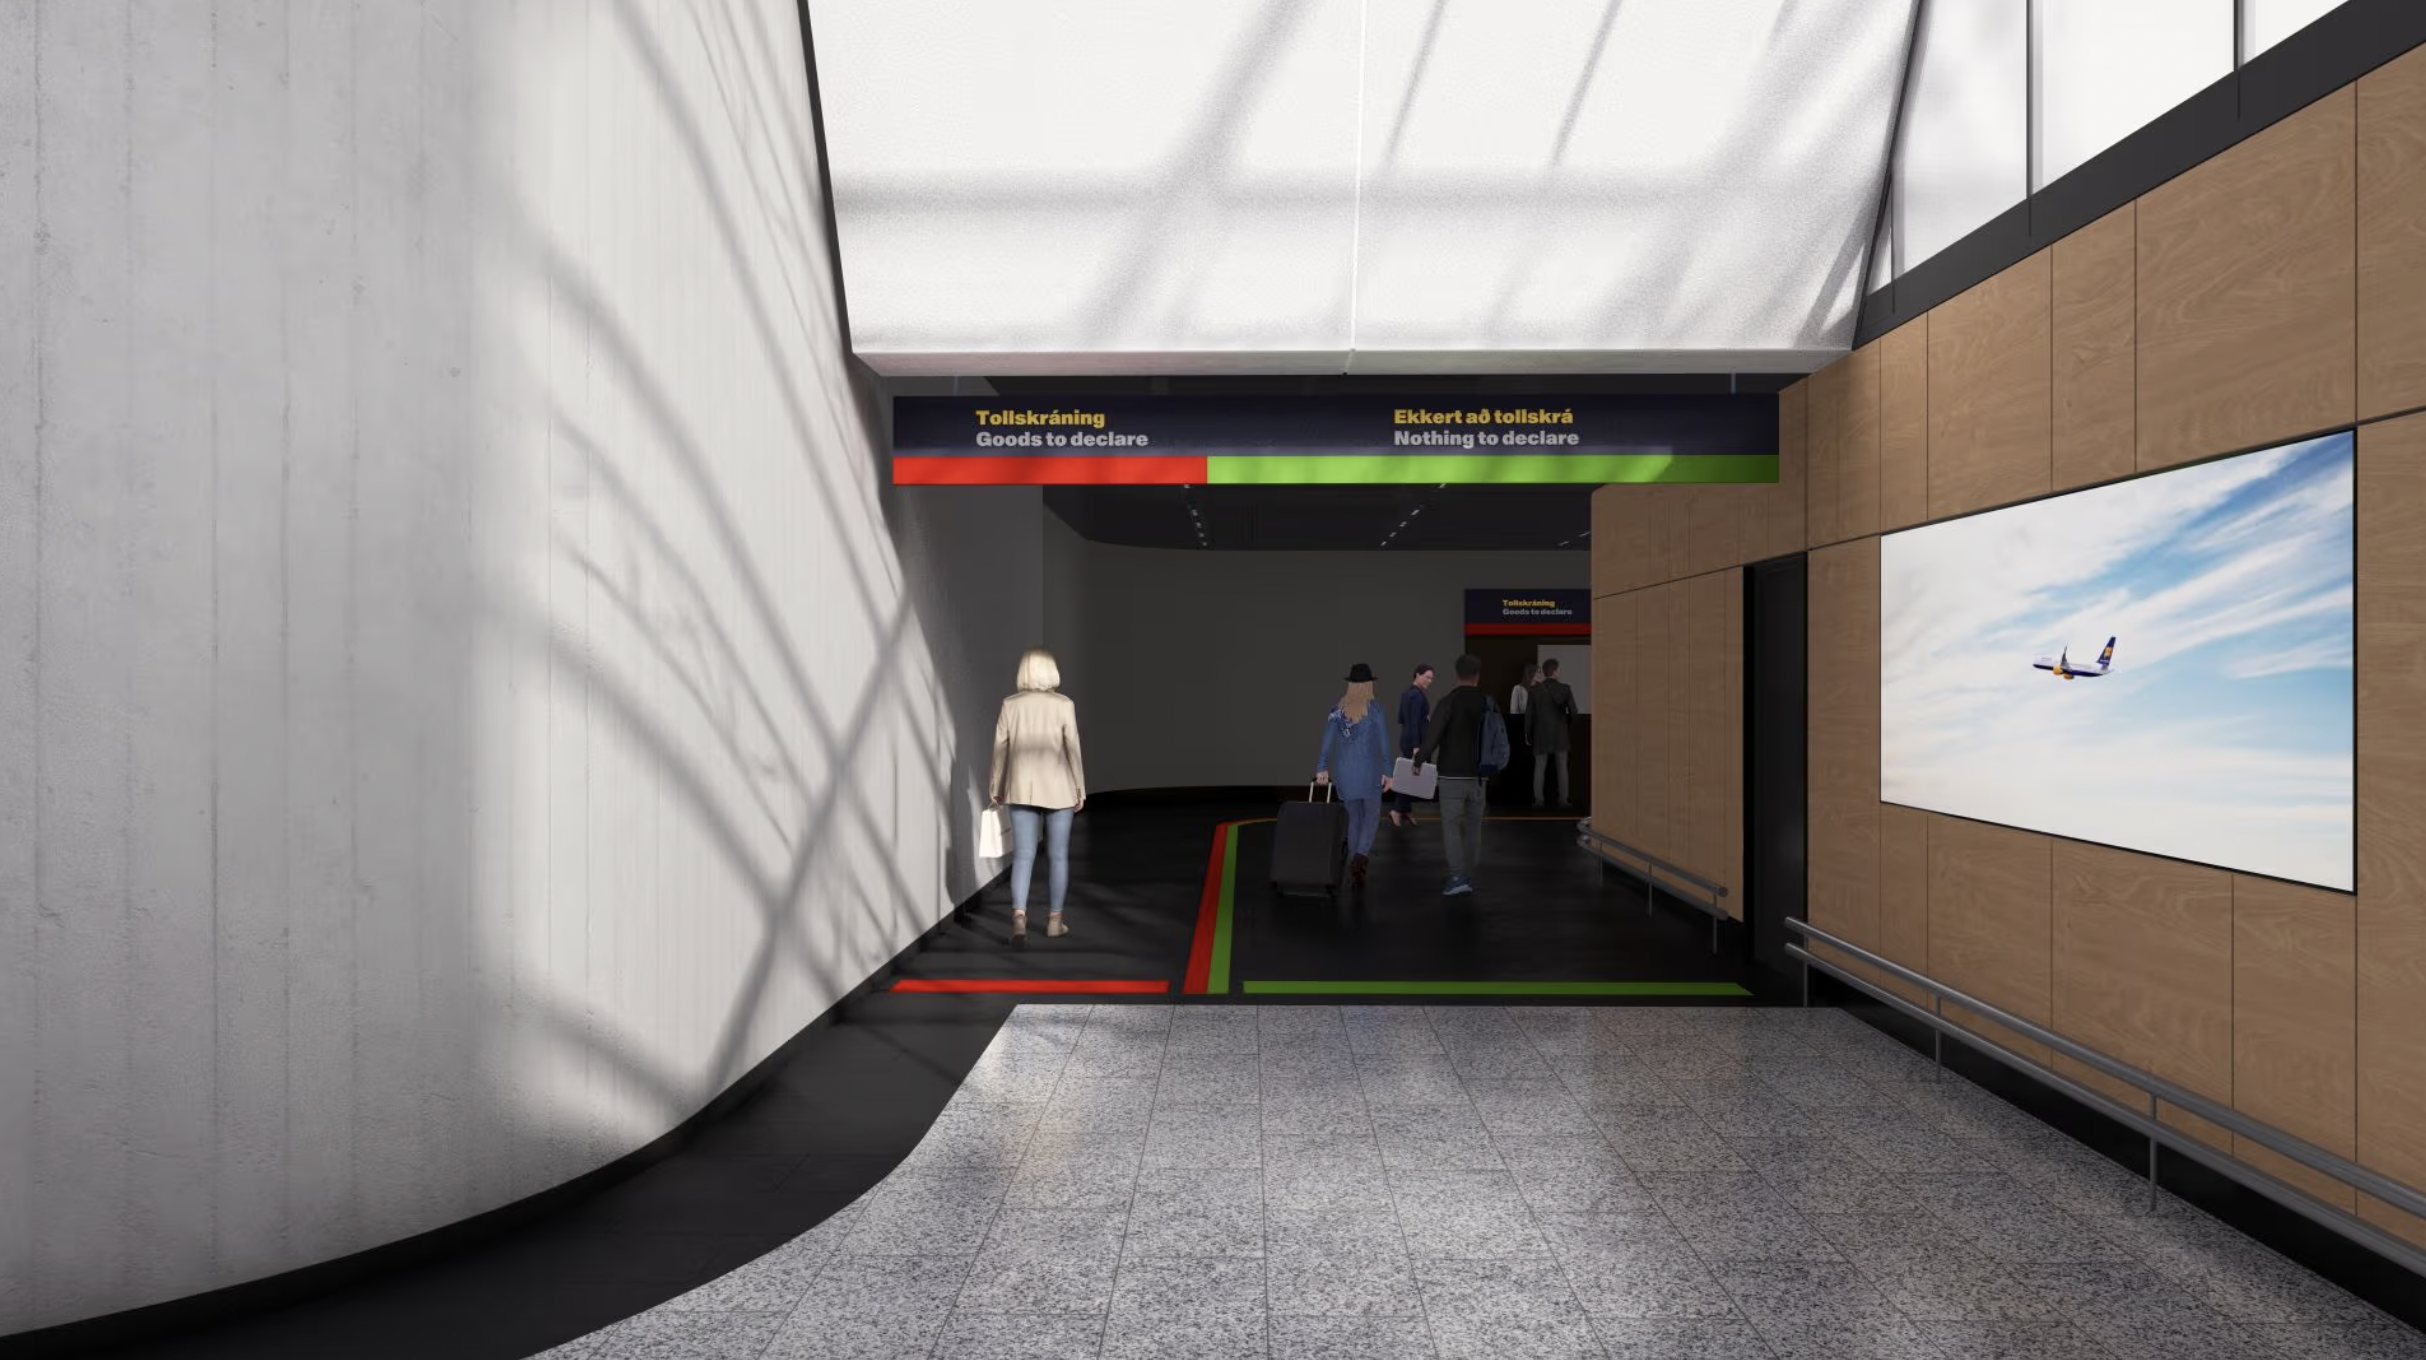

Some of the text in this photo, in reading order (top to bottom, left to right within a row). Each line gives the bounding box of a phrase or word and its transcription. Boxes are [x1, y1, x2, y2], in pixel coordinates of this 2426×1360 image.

[975, 409, 1105, 429] Tollskráning
[1394, 408, 1573, 424] Ekkert að tollskrá
[975, 431, 1148, 447] Goods to declare
[1394, 430, 1579, 449] Nothing to declare
[1502, 608, 1530, 616] Goods
[1531, 608, 1540, 616] to
